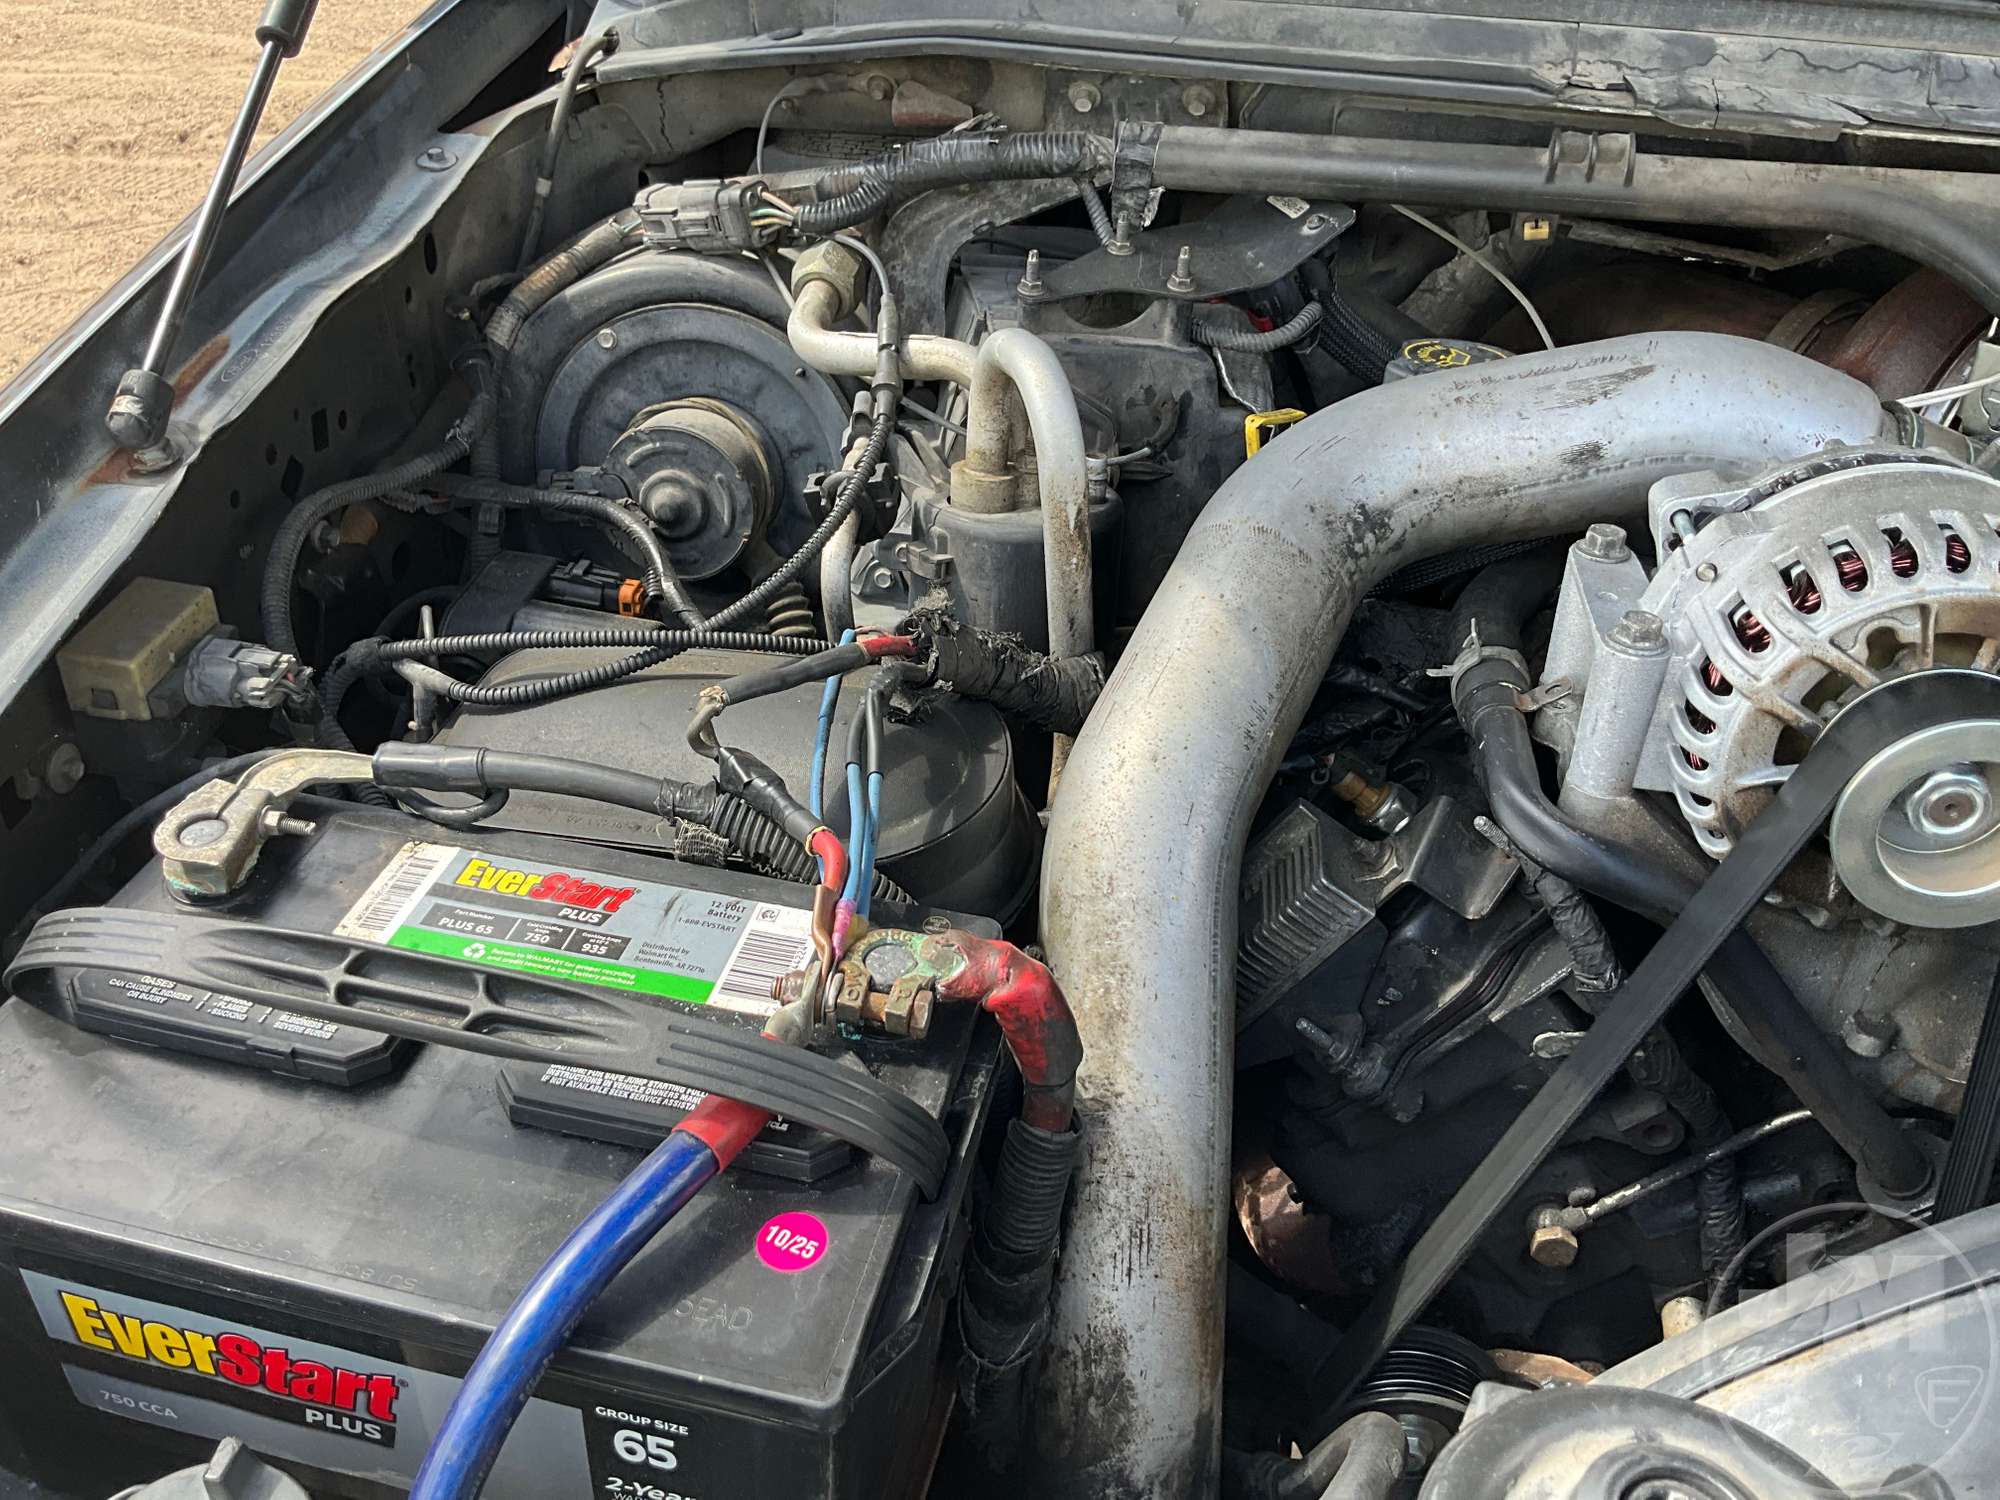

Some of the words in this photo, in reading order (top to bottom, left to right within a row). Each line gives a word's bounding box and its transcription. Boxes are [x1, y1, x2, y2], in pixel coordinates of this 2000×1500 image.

[455, 857, 636, 913] EverStart
[438, 917, 473, 931] PLUS
[475, 924, 495, 935] 65
[558, 908, 602, 924] PLUS
[707, 909, 742, 922] Battery
[523, 932, 551, 945] 750
[580, 943, 608, 955] 935
[641, 941, 681, 954] Distributed
[681, 946, 690, 955] by
[638, 948, 668, 960] Walmart
[675, 961, 688, 971] AR
[540, 1073, 551, 1082] IF
[549, 1076, 568, 1086] NOT
[566, 1080, 610, 1095] AVAILABLE
[608, 1088, 630, 1099] SEEK
[629, 1091, 662, 1105] SERVICE
[661, 1097, 696, 1111] ASSISTA
[545, 1067, 603, 1085] INSTRUCTIONS
[613, 1080, 646, 1094] VEHICLE
[645, 1086, 680, 1100] OWNERS
[765, 1225, 819, 1259] 10/25
[58, 1288, 400, 1424] EverStart
[99, 1390, 137, 1408] 750
[138, 1401, 179, 1419] CCA
[305, 1407, 384, 1440] PLUS
[595, 1405, 652, 1425] GROUP
[653, 1419, 690, 1436] SIZE
[613, 1429, 678, 1470] 65
